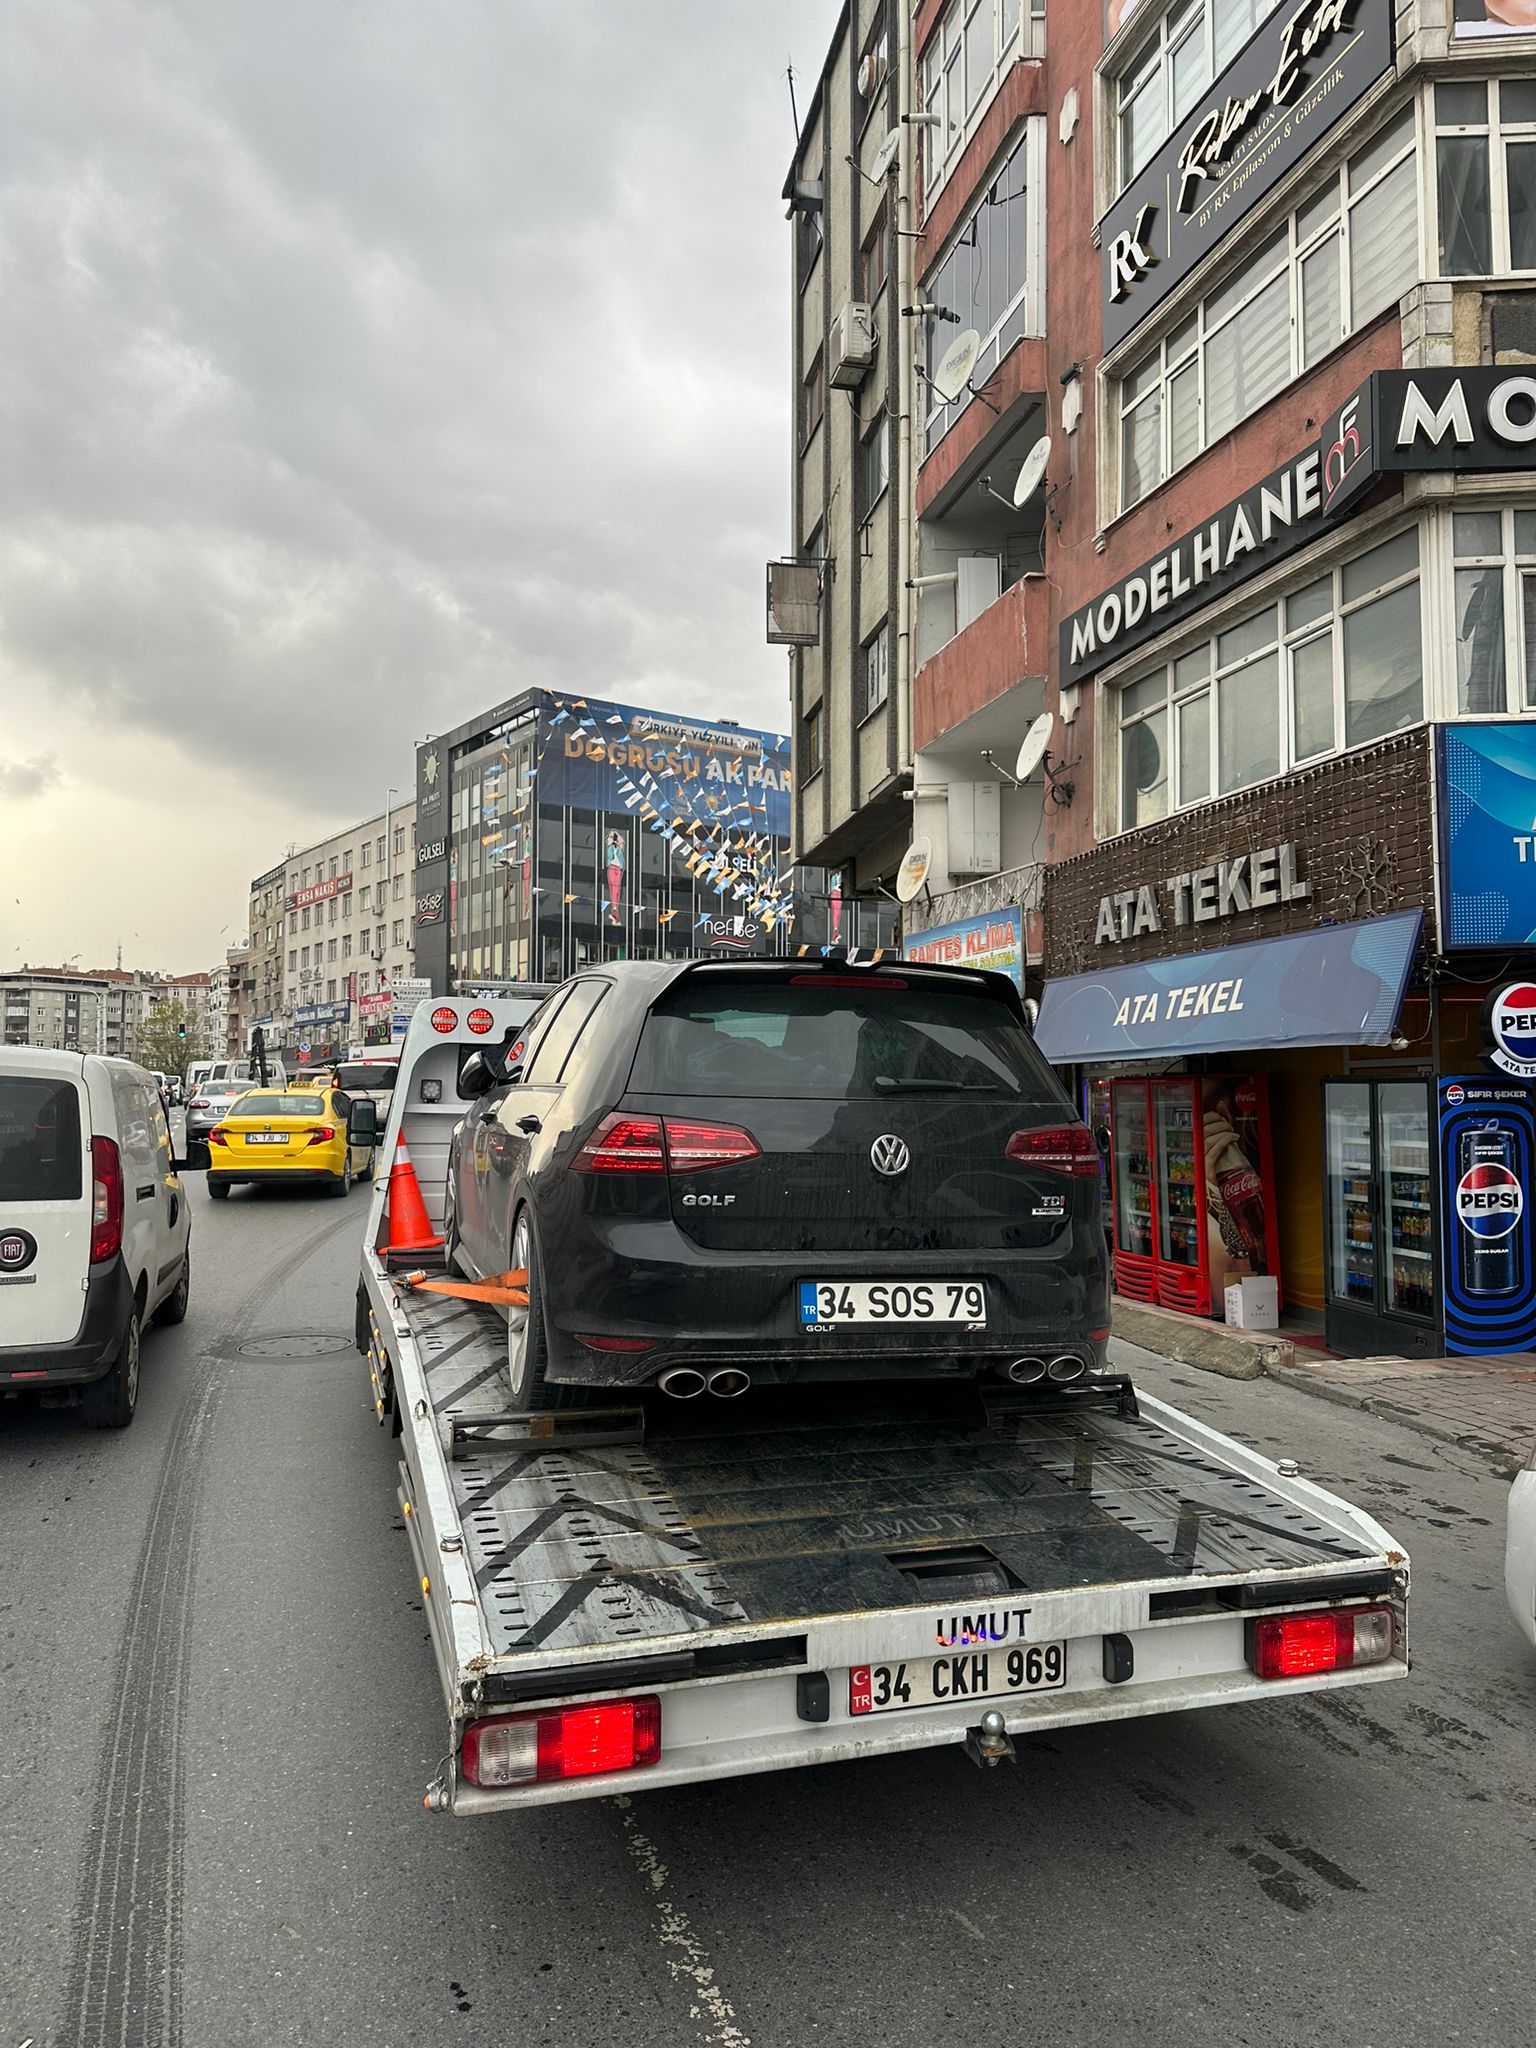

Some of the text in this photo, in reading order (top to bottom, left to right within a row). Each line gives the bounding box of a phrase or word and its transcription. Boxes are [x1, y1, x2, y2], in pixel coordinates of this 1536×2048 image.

[1247, 109, 1277, 147] SALON
[1199, 68, 1345, 228] BY RK Epilasyon & Güzellik
[1108, 202, 1150, 303] RK
[1070, 449, 1323, 667] MODELHANE
[706, 757, 743, 786] AK
[418, 837, 445, 863] GÜLSELİ
[1513, 836, 1536, 862] T
[1095, 843, 1312, 944] ATA TEKEL
[704, 919, 757, 939] nefse
[966, 921, 1015, 957] KLİMA
[1112, 978, 1245, 1027] ATA TEKEL
[1502, 1059, 1521, 1074] ATA
[1467, 1090, 1493, 1099] SIFIR
[1494, 1090, 1527, 1100] ŞEKER
[681, 1193, 736, 1207] GOLF
[1041, 1195, 1066, 1207] TDI
[1460, 1192, 1519, 1209] PEPSI
[4, 1243, 22, 1257] FIAT
[803, 1286, 983, 1318] TR 34 SOS 79
[805, 1324, 836, 1332] GOLF
[935, 1608, 1032, 1647] UMUT
[852, 1645, 1062, 1709] TR 34 CKH 969
